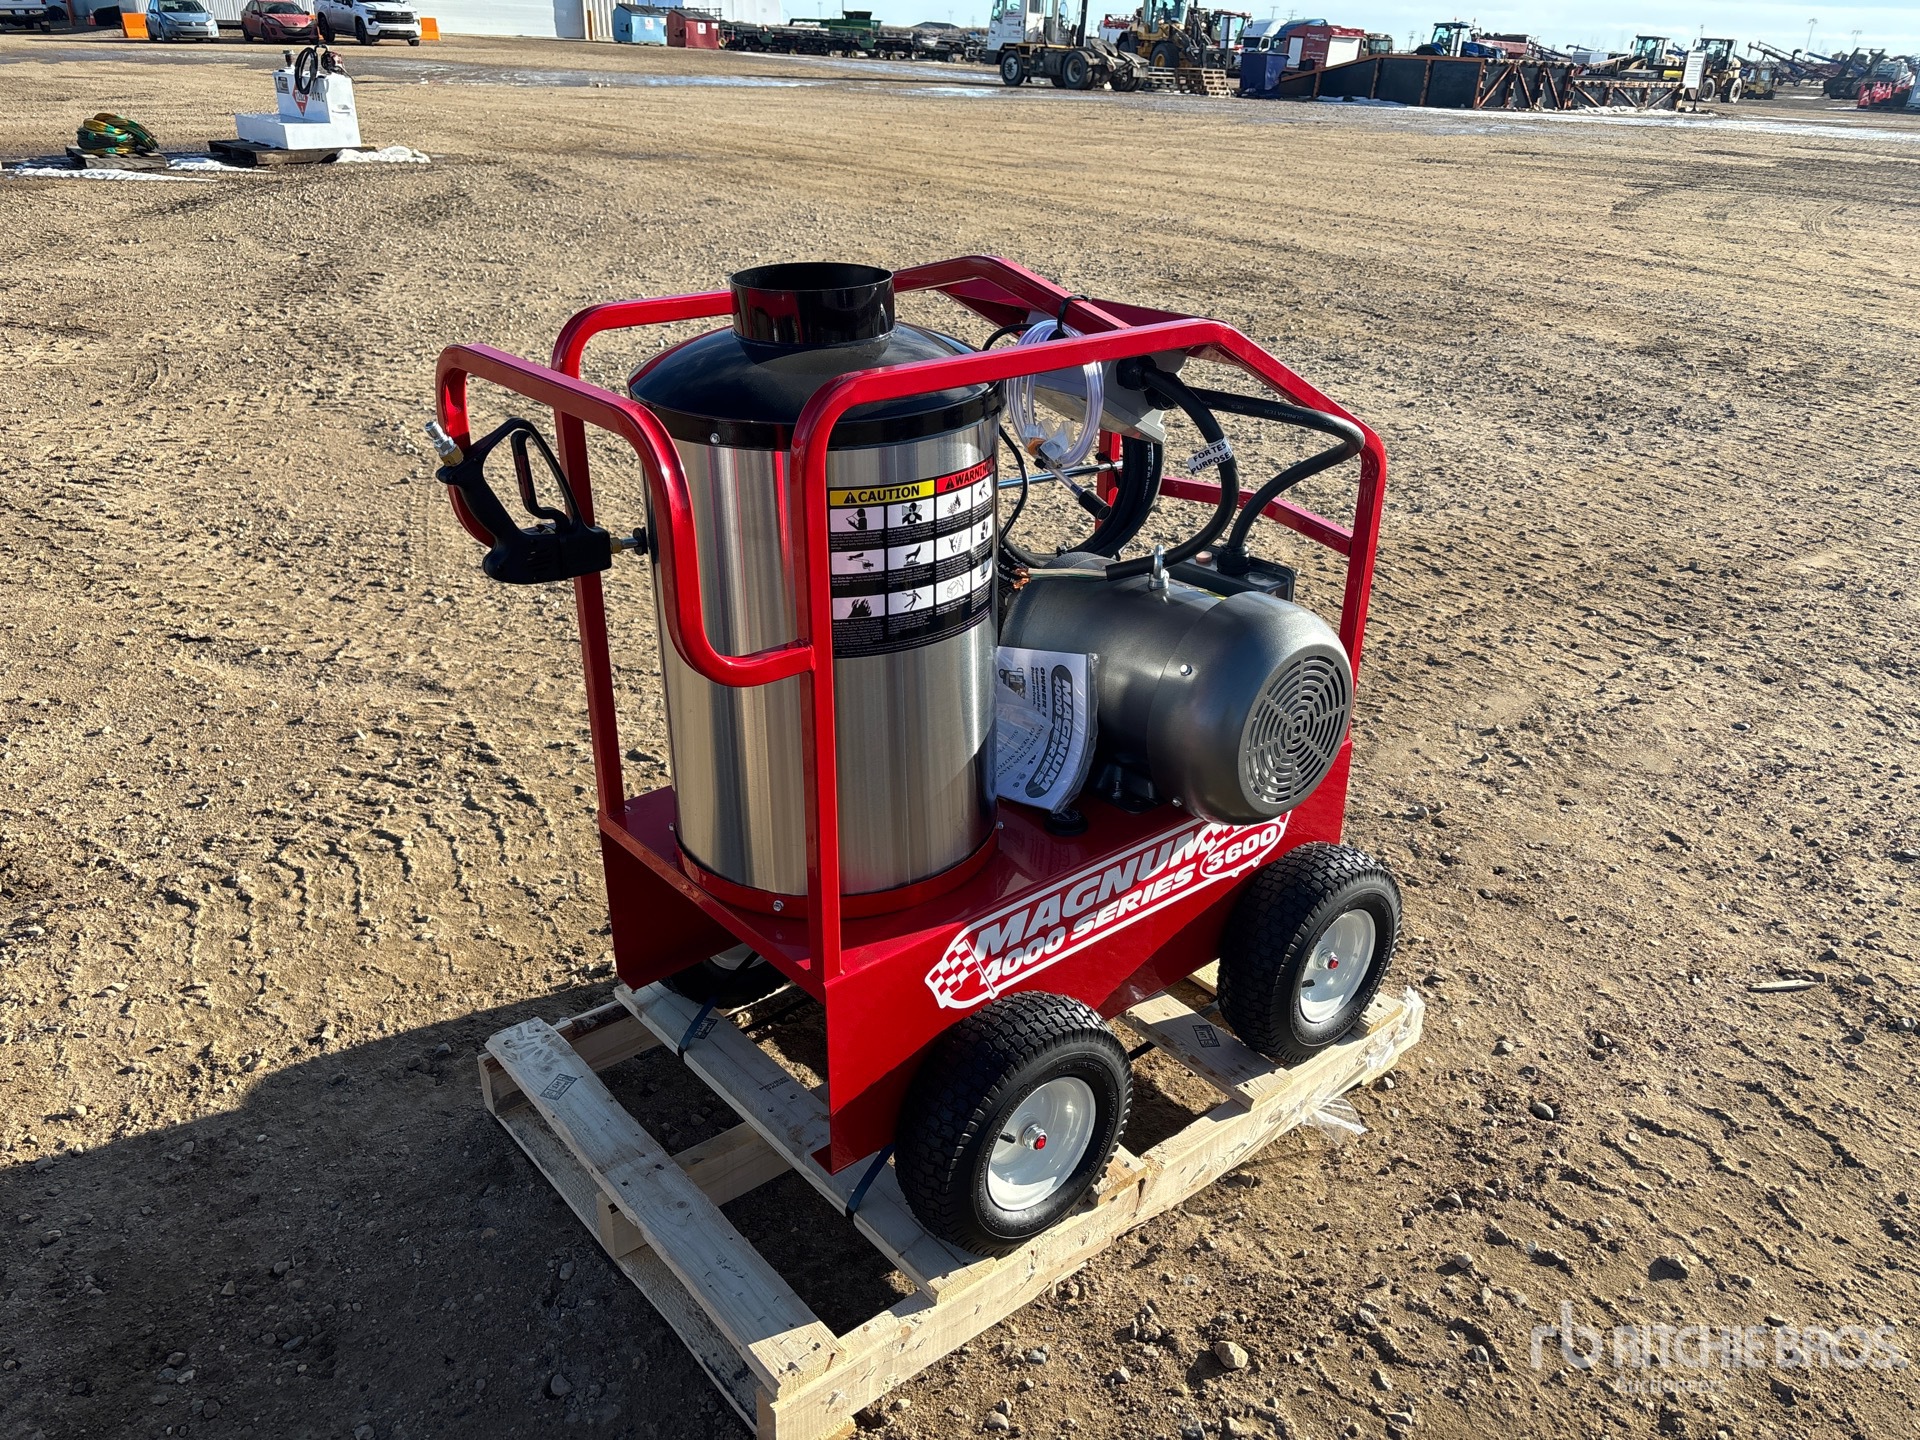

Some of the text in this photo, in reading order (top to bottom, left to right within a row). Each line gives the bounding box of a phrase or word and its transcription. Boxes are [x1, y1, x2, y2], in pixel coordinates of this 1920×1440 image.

[1191, 451, 1231, 475] PURPOSE
[1193, 449, 1212, 463] FOR
[858, 485, 920, 503] CAUTION
[1054, 677, 1064, 713] 4000
[1013, 724, 1045, 765] INSTRUCTION
[1014, 736, 1031, 755] NEMA
[1032, 715, 1062, 786] SERIES
[1040, 679, 1072, 793] MAGNUM
[974, 824, 1214, 961] MAGNUM
[980, 825, 1278, 986] 4000 SERIES 3600
